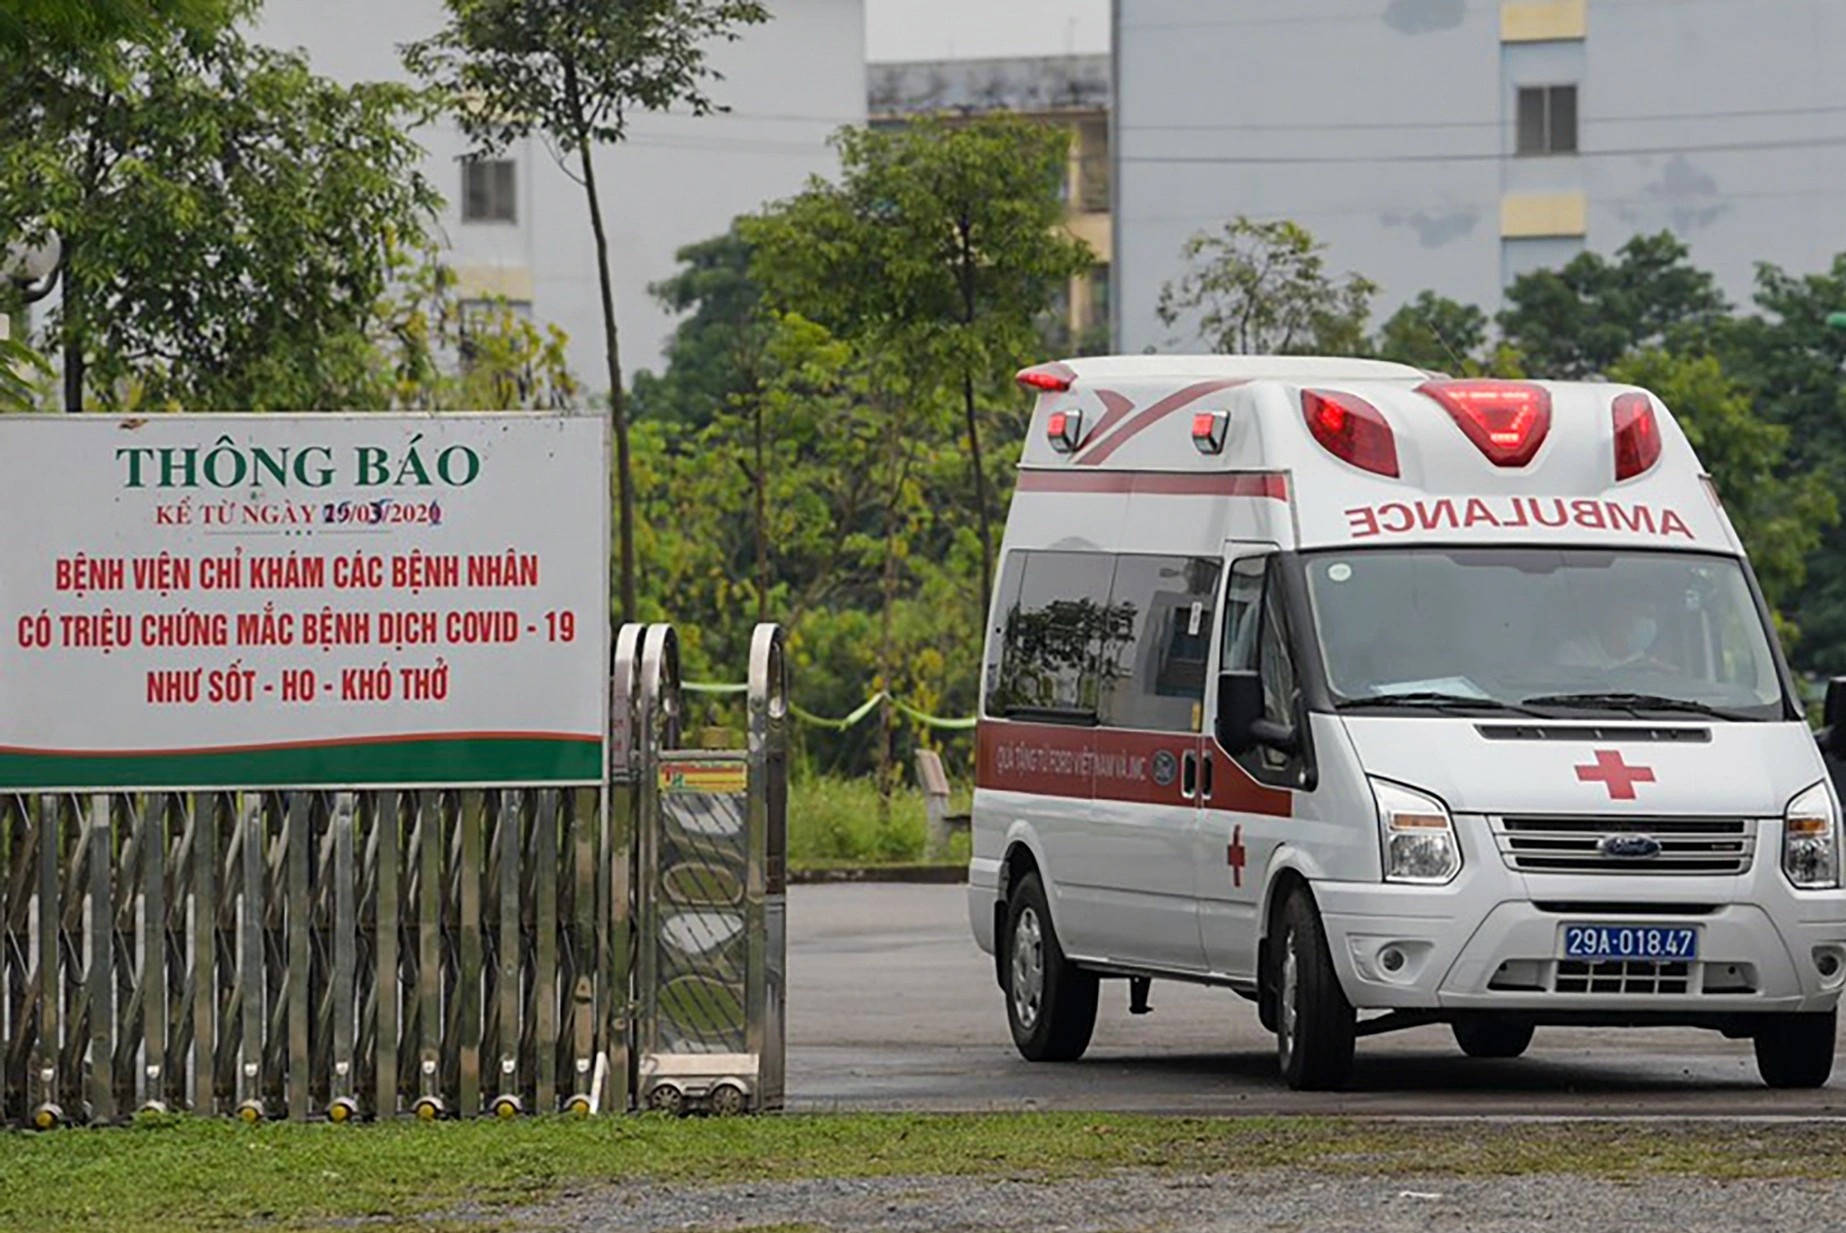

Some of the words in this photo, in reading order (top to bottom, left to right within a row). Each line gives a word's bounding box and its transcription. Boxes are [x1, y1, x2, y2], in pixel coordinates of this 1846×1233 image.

[116, 435, 335, 488] THÔNG
[355, 434, 480, 487] BÁO
[200, 499, 237, 525] TỪ
[243, 499, 316, 526] NGÀY
[56, 552, 125, 598] BỆNH
[133, 551, 191, 598] VIỆN
[199, 546, 242, 591] CHỈ
[250, 550, 325, 590] KHÁM
[333, 549, 384, 589] CÁC
[391, 549, 460, 595] BỆNH
[467, 548, 539, 588] NHÂN
[18, 608, 52, 648] CÓ
[60, 607, 133, 654] TRIỆU
[141, 607, 229, 648] CHỨNG
[236, 601, 295, 647] MẮC
[302, 605, 370, 652] BỆNH
[378, 612, 438, 651] DỊCH
[446, 610, 520, 645] COVID
[545, 610, 576, 644] 19
[147, 667, 203, 704] NHƯ
[208, 658, 257, 702] SỐT
[282, 669, 317, 703] HO
[341, 661, 394, 701] KHÓ
[400, 656, 449, 701] THỞ
